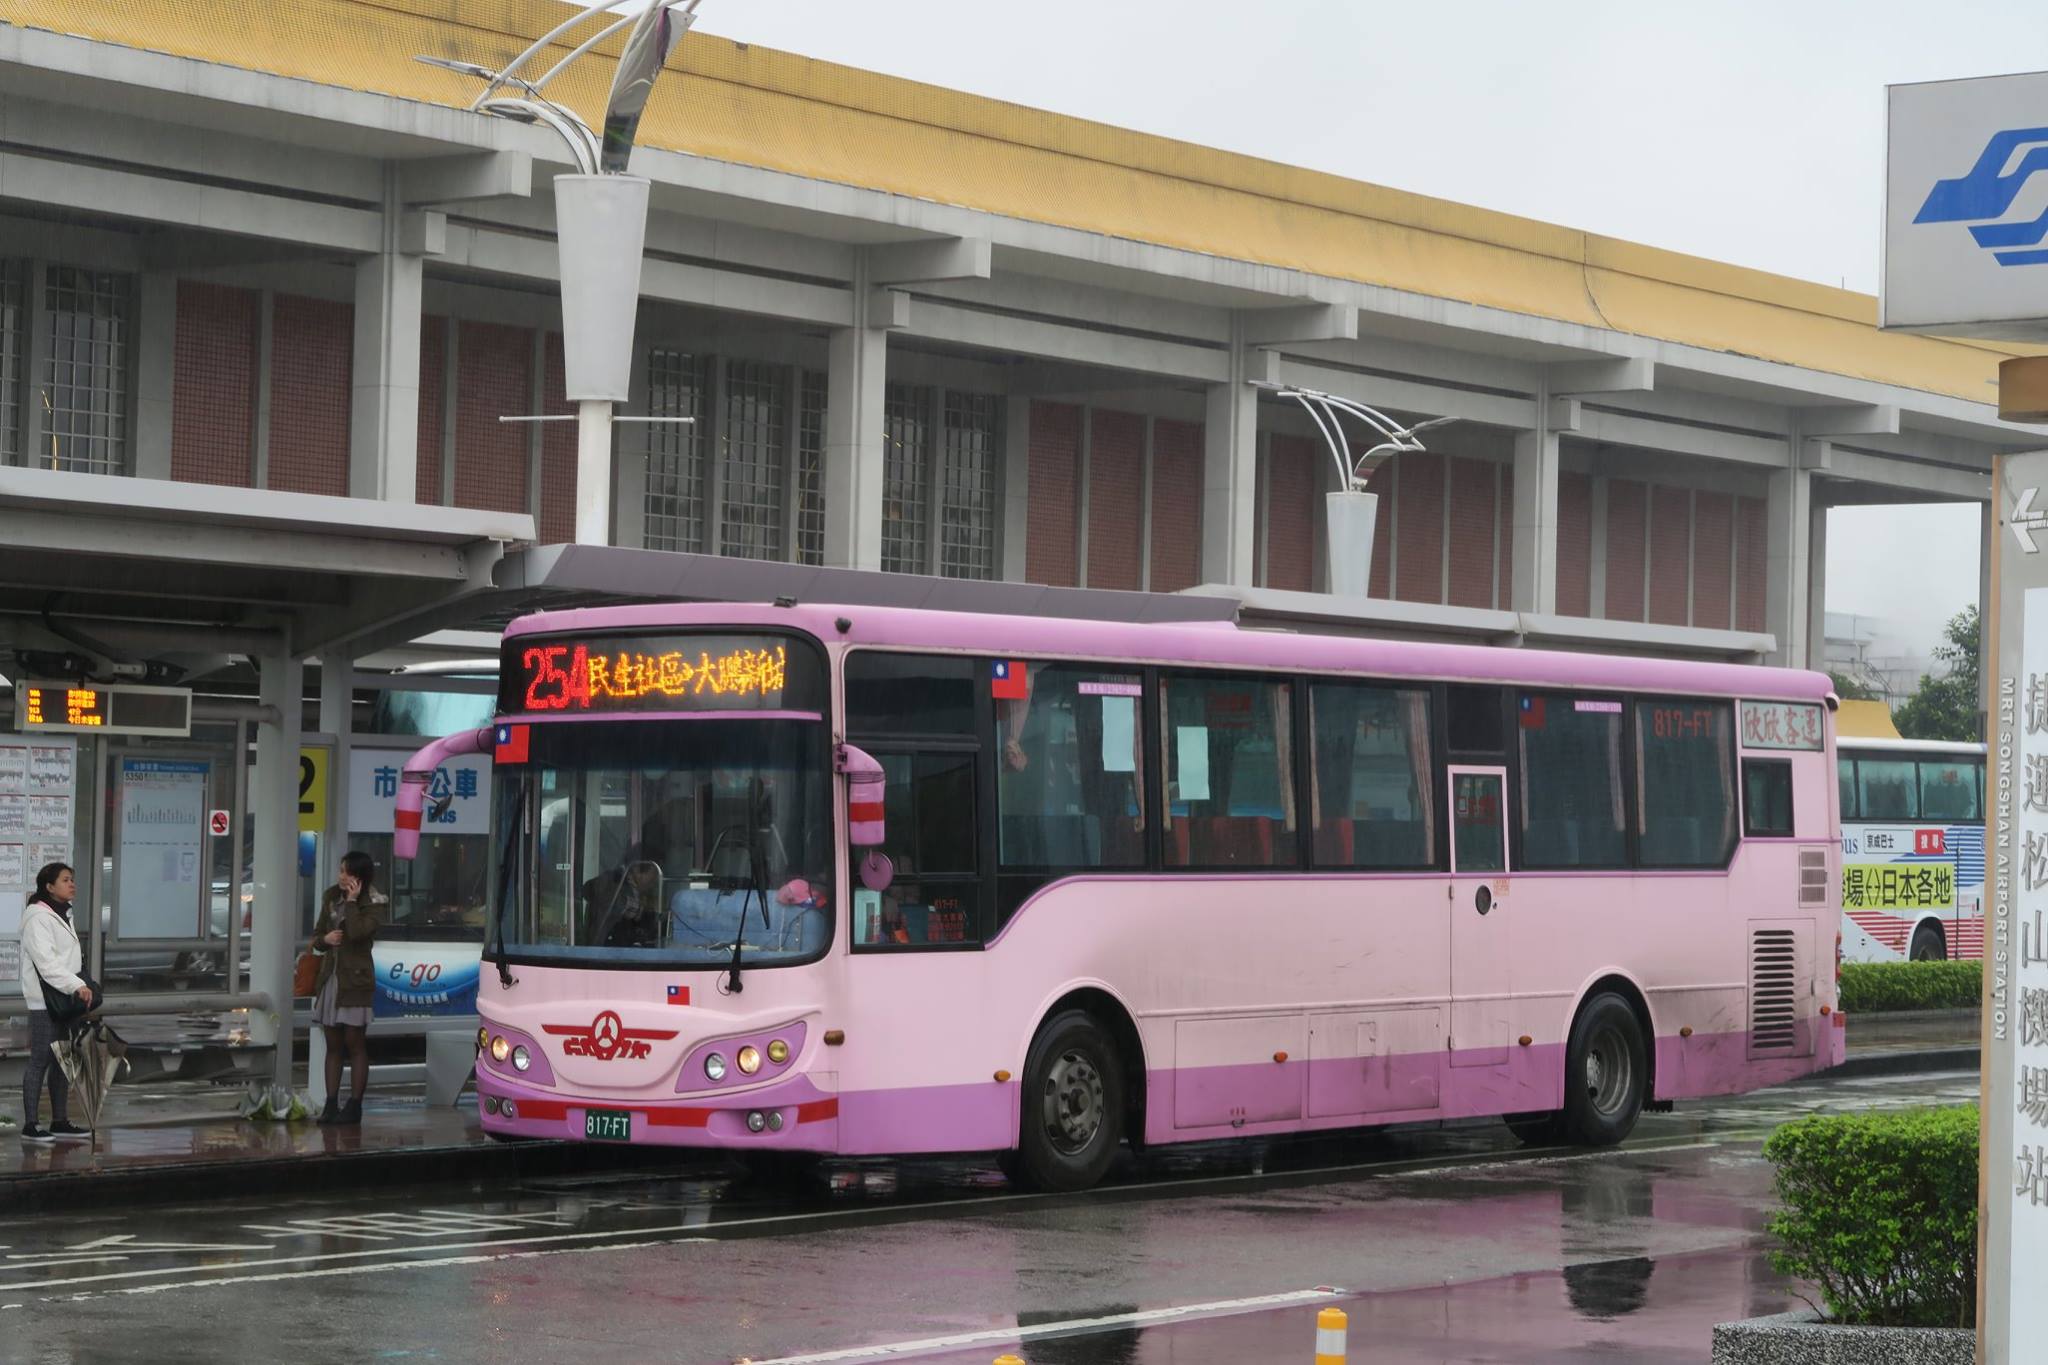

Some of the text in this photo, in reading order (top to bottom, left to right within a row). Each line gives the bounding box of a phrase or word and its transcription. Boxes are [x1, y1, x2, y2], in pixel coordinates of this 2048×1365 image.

[523, 645, 590, 709] 254
[588, 652, 685, 696] 民生社區
[1653, 709, 1713, 737] 817-FT
[1743, 705, 1821, 746] 欣欣客運
[373, 765, 478, 800] 市公車
[1994, 677, 2015, 1041] MRT SONGSHAN AIRPORT STATION
[1842, 867, 1951, 907] 場 日本各地
[389, 962, 441, 988] e-go
